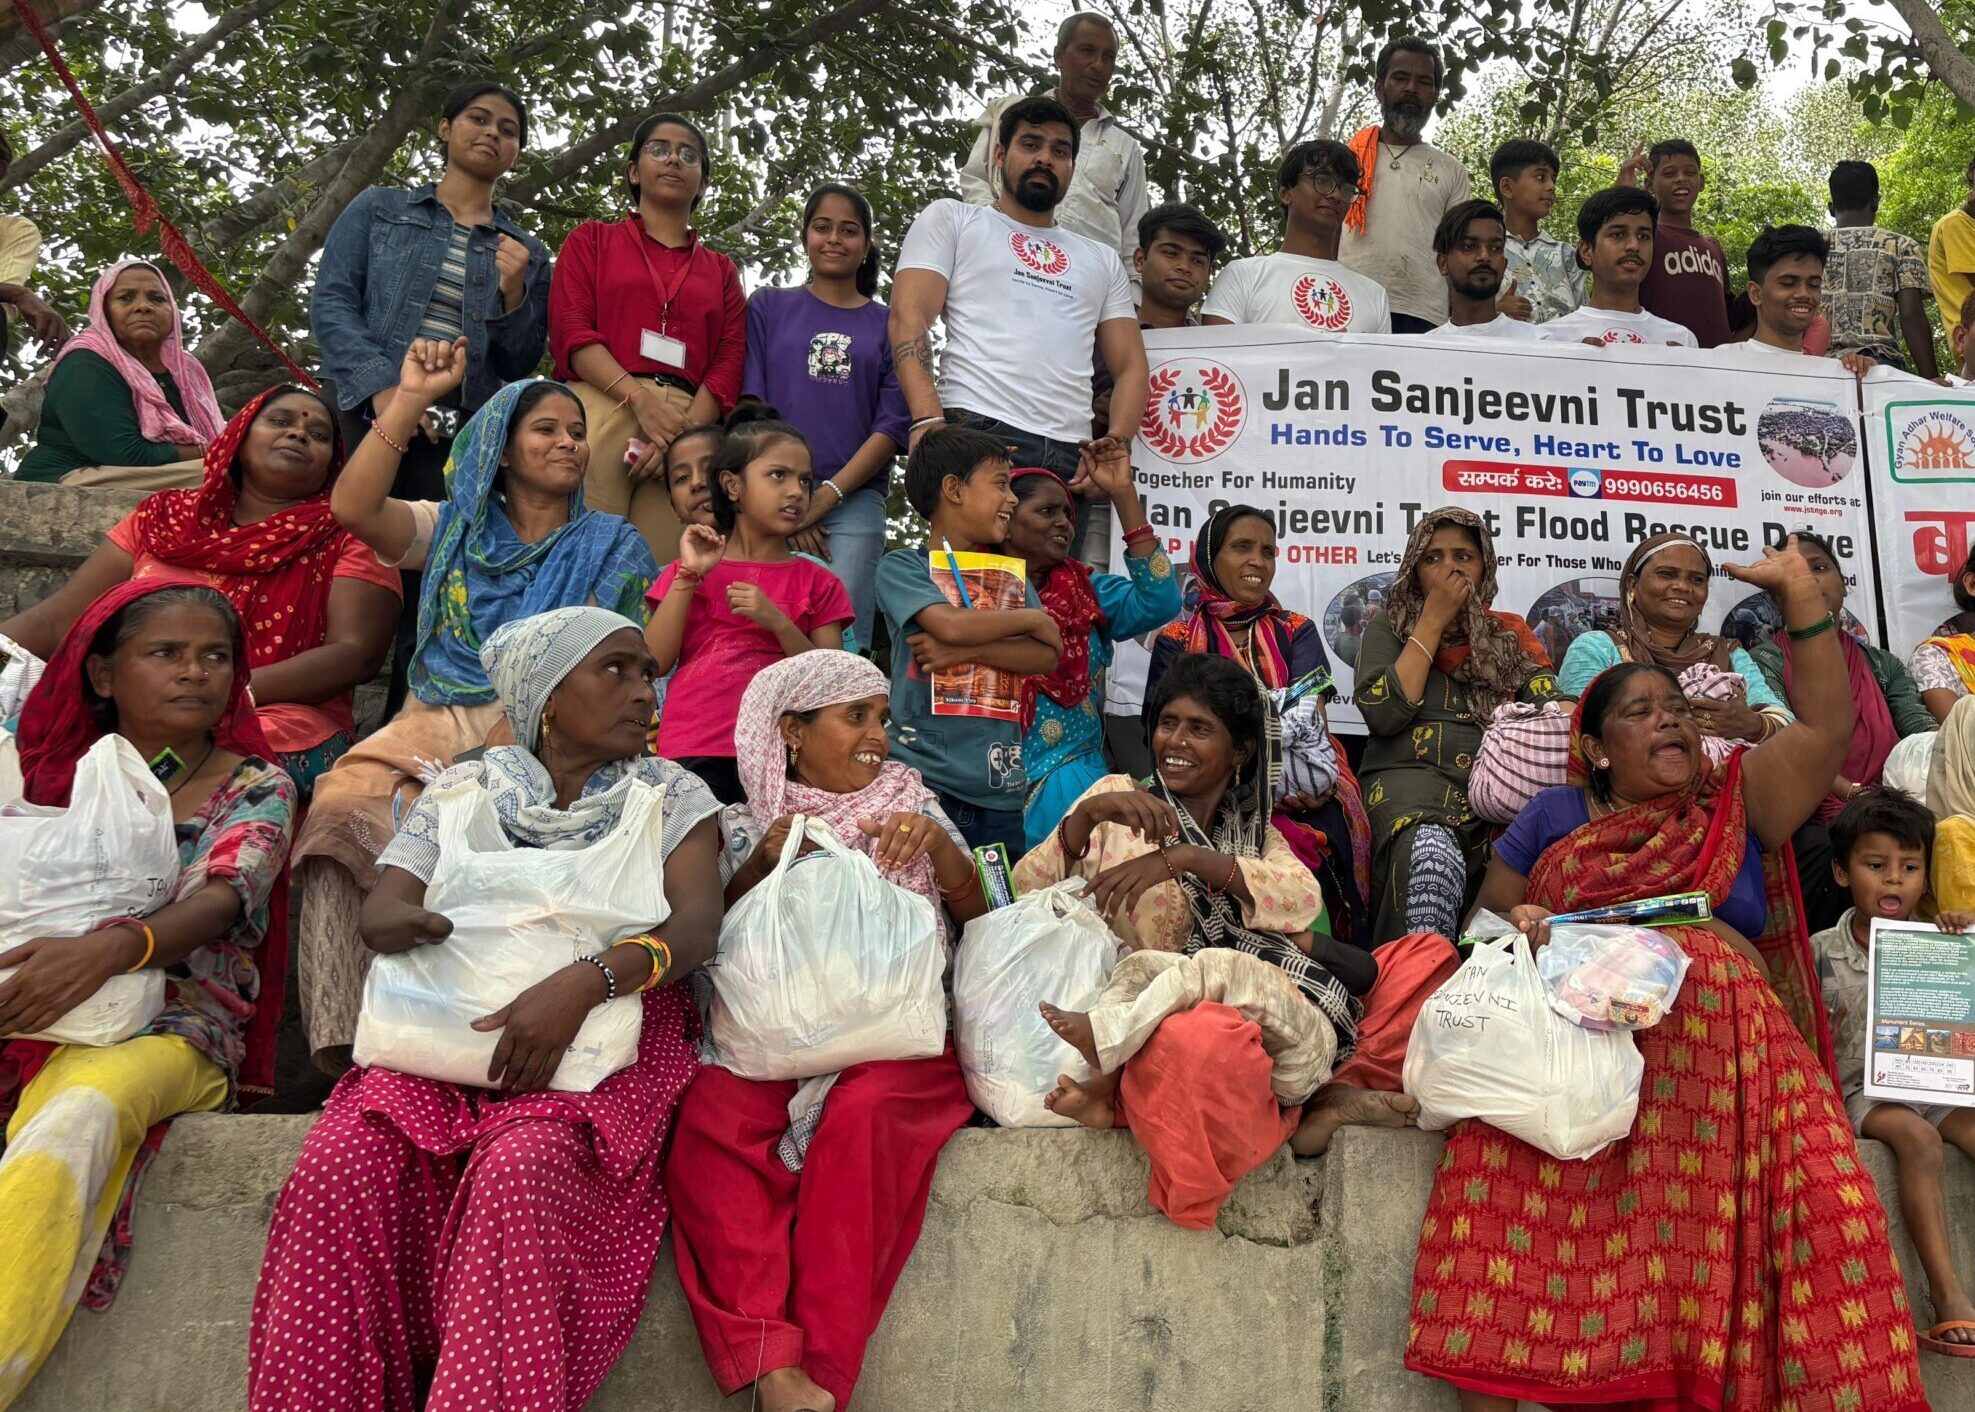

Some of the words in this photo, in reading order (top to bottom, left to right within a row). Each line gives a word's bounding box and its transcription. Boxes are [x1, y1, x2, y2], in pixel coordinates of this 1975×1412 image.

[1263, 368, 1350, 412] Jan
[1371, 369, 1599, 426] Sanjeevni
[1617, 388, 1747, 436] Trust
[1271, 423, 1368, 447] Hands
[1380, 425, 1413, 448] To
[1425, 427, 1521, 457] Serve,
[1534, 434, 1621, 461] Heart
[1632, 440, 1663, 463] To
[1676, 443, 1742, 469] Love
[1895, 441, 1906, 469] Gyan
[1902, 415, 1927, 440] Adhar
[1929, 411, 1965, 430] Welfare
[1222, 471, 1254, 489] For
[1262, 471, 1356, 494] Humanity
[1457, 468, 1520, 487] सम्पर्क
[1604, 477, 1723, 502] 9990656456
[1760, 490, 1782, 503] join
[1785, 493, 1804, 503] our
[1808, 494, 1847, 506] efforts
[1850, 498, 1861, 507] at
[1516, 506, 1609, 542] Flood
[1287, 545, 1358, 565] OTHER
[1367, 550, 1401, 564] Let's
[1518, 554, 1541, 567] For
[1546, 555, 1587, 570] Those
[1591, 557, 1622, 572] Who
[1436, 1010, 1491, 1032] TRUST
